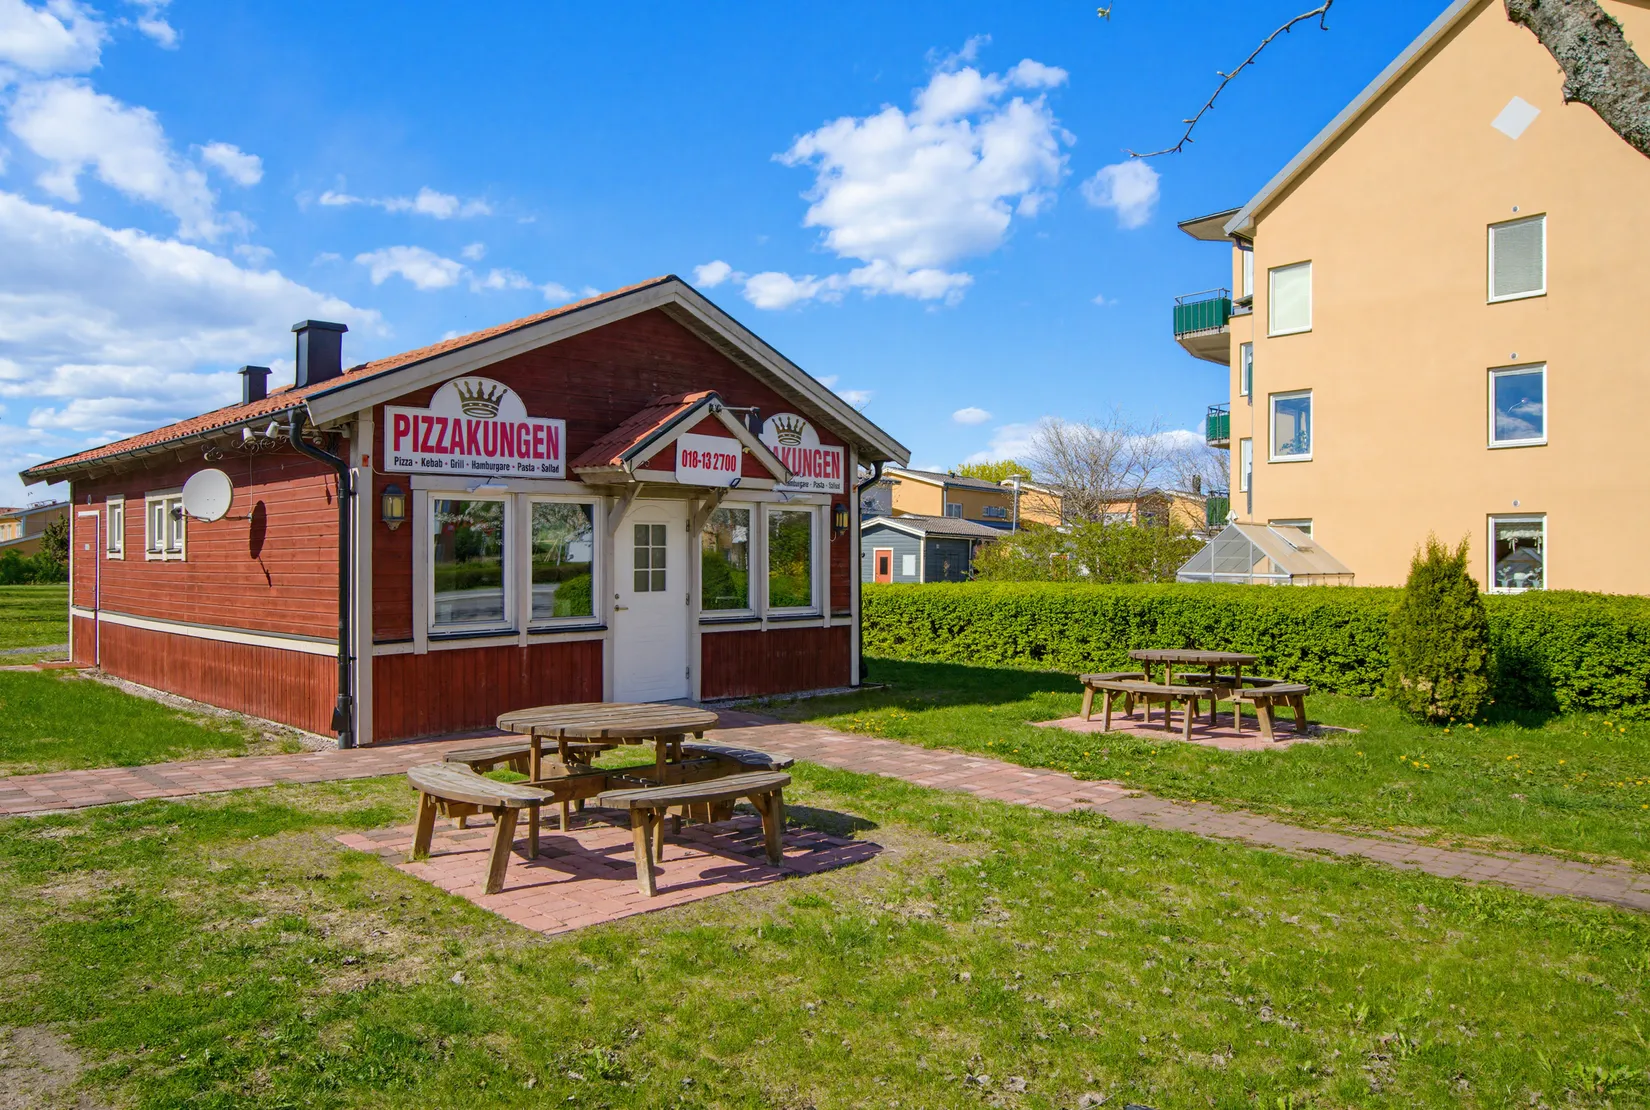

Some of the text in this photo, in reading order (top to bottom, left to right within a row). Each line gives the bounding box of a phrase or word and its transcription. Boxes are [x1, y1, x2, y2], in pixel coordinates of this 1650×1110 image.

[393, 413, 559, 460] PIZZAKUNGEN
[394, 456, 559, 473] Pizza Kebab Grill Hamburgare Pasta Sallad
[681, 449, 737, 472] 018-13 2700
[813, 481, 825, 489] Pasta
